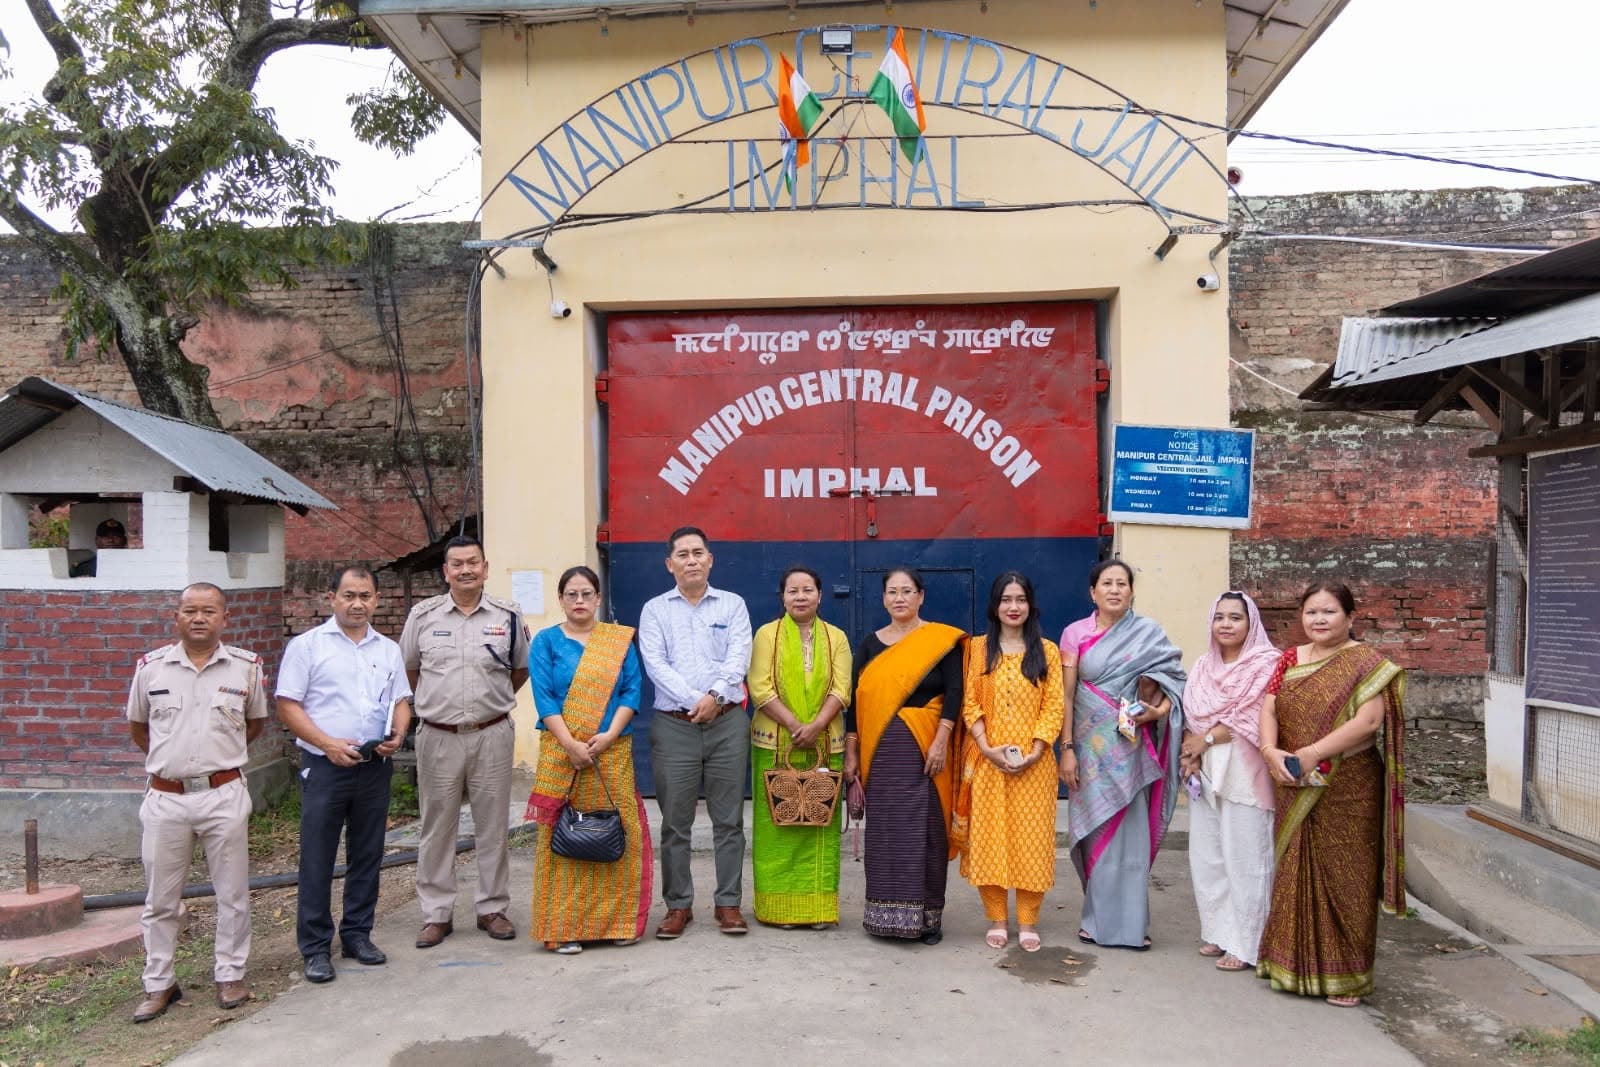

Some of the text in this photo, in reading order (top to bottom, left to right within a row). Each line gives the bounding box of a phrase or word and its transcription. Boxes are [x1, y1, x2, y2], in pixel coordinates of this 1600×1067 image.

[507, 38, 779, 225] MANIPUR
[1071, 101, 1195, 219] JAIL
[727, 138, 985, 211] IMPHAL
[658, 368, 1042, 496] MANIPUR CENTRAL PRISON
[1168, 441, 1199, 450] NOTICE
[1117, 451, 1156, 460] MANIPUR
[1157, 453, 1194, 463] CENTRAL
[1218, 455, 1249, 465] IMPHAL
[1186, 466, 1209, 474] HOURS
[764, 467, 938, 499] IMPHAL
